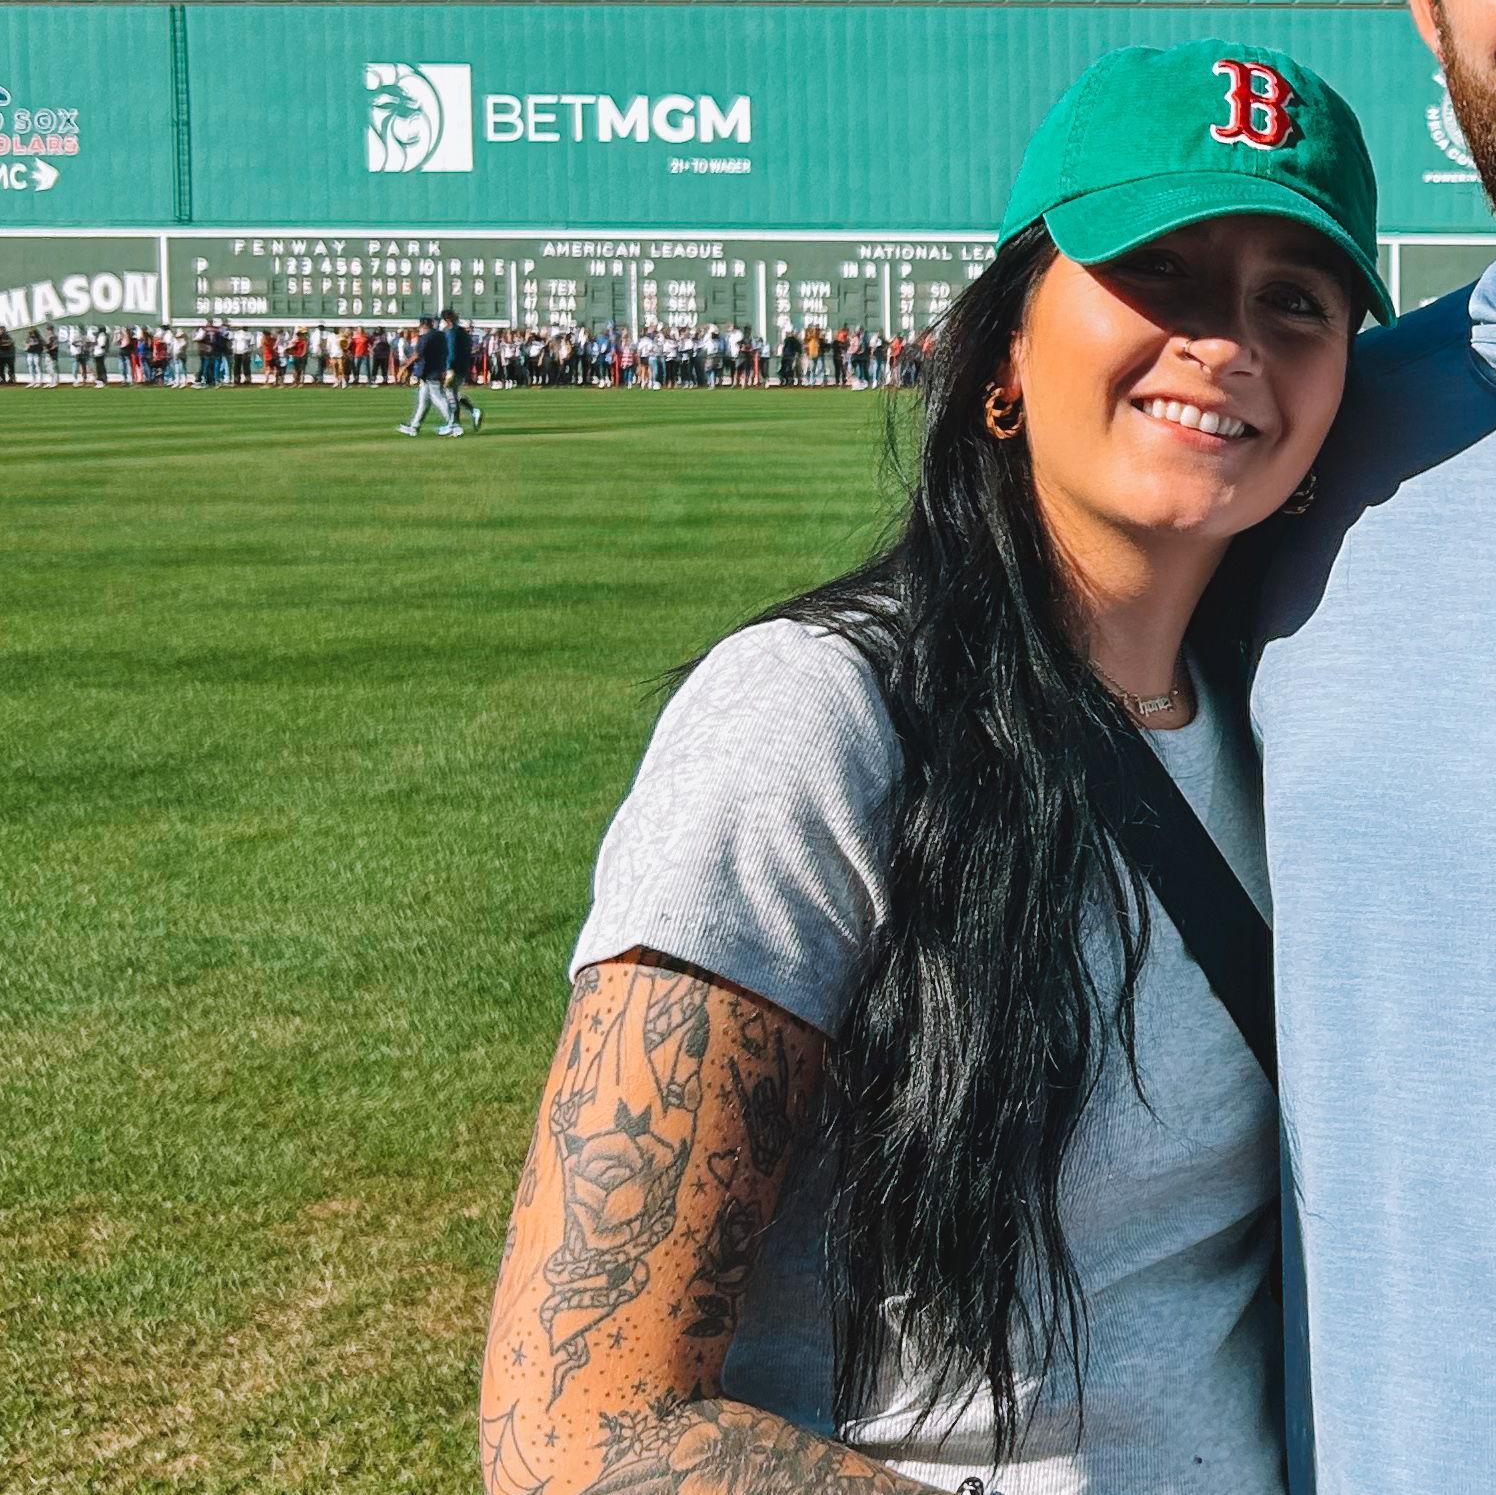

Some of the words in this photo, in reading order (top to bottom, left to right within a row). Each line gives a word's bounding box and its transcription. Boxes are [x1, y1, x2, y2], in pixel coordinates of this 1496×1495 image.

[1210, 59, 1294, 151] B
[14, 108, 80, 135] SOX
[485, 94, 751, 144] BETMGM
[691, 157, 708, 174] TO
[234, 239, 347, 256] FENWAY
[368, 240, 441, 257] PARK
[543, 241, 641, 258] AMERICAN
[650, 242, 724, 259] LEAGUE
[860, 244, 953, 260] NATIONAL
[549, 279, 577, 296] TEX
[668, 279, 697, 296] OAK
[0, 271, 160, 332] MASON
[214, 297, 268, 315] BOSTON
